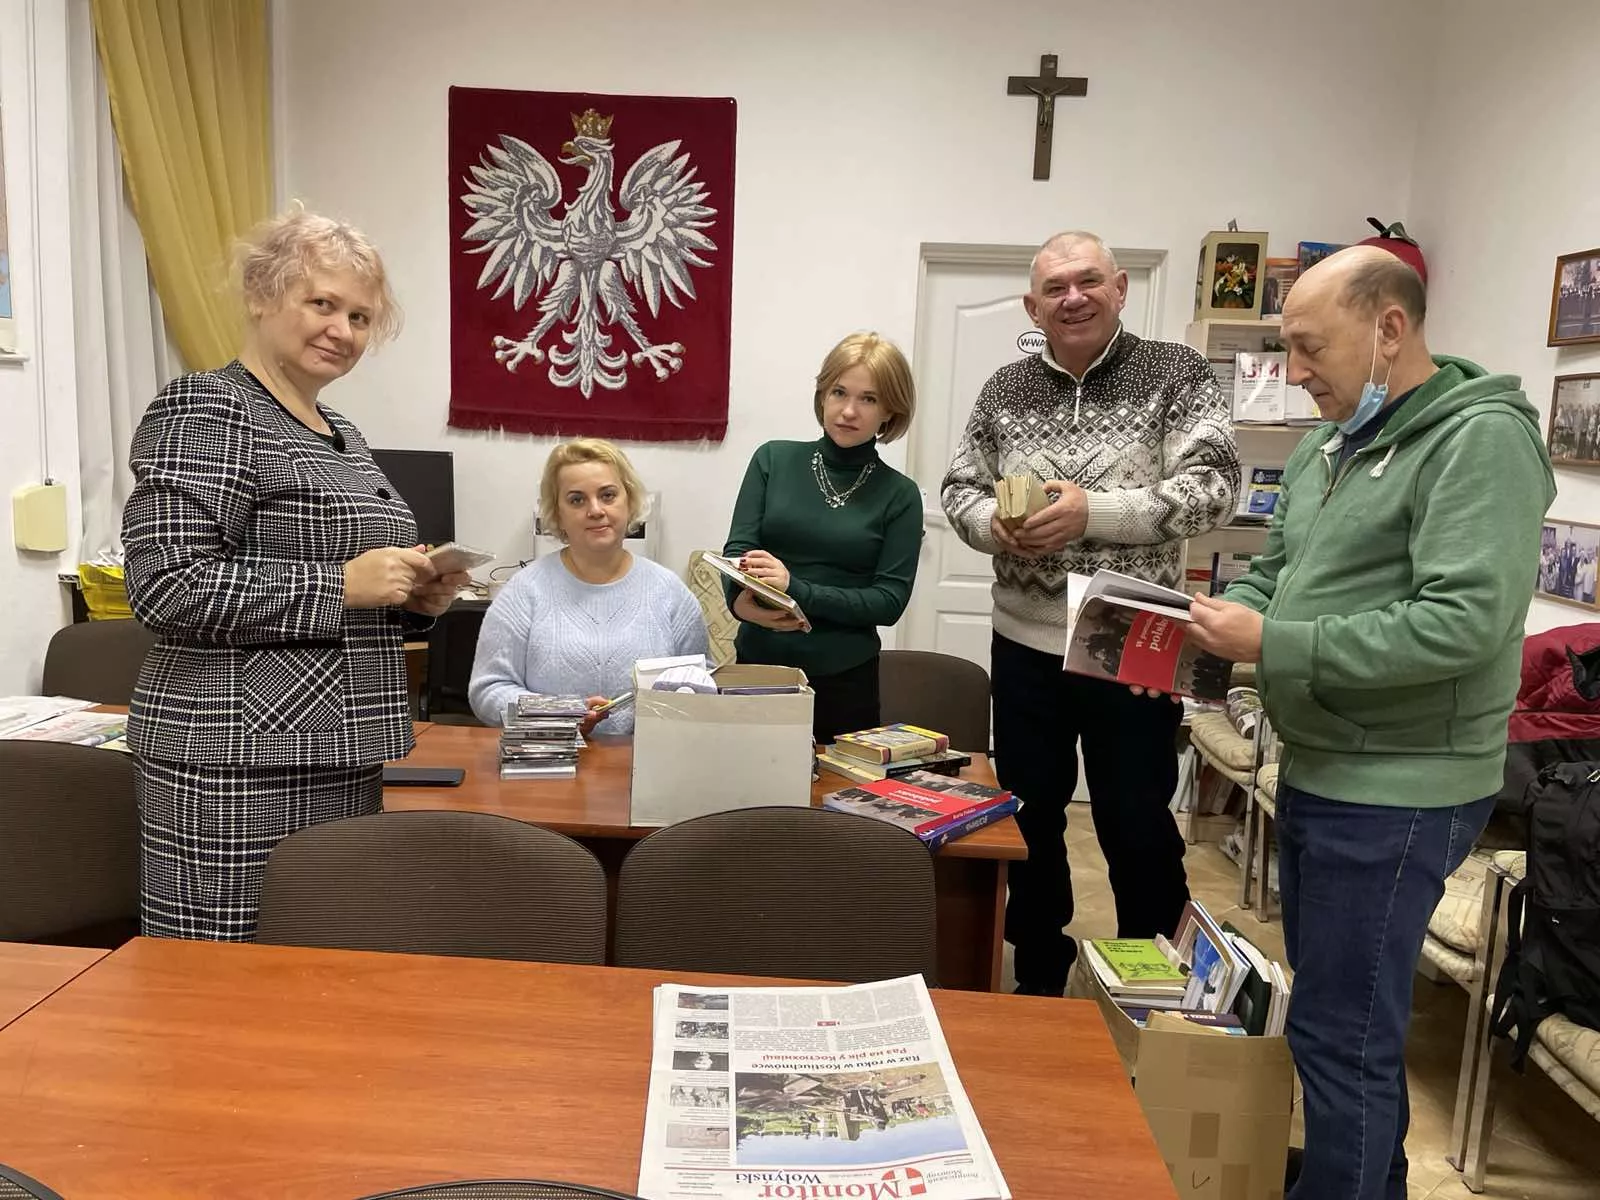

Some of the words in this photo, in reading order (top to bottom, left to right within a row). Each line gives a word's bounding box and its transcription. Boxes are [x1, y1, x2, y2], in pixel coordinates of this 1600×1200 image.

[856, 1059, 883, 1068] roku
[899, 1055, 920, 1063] Raz
[757, 1182, 902, 1200] Monitor
